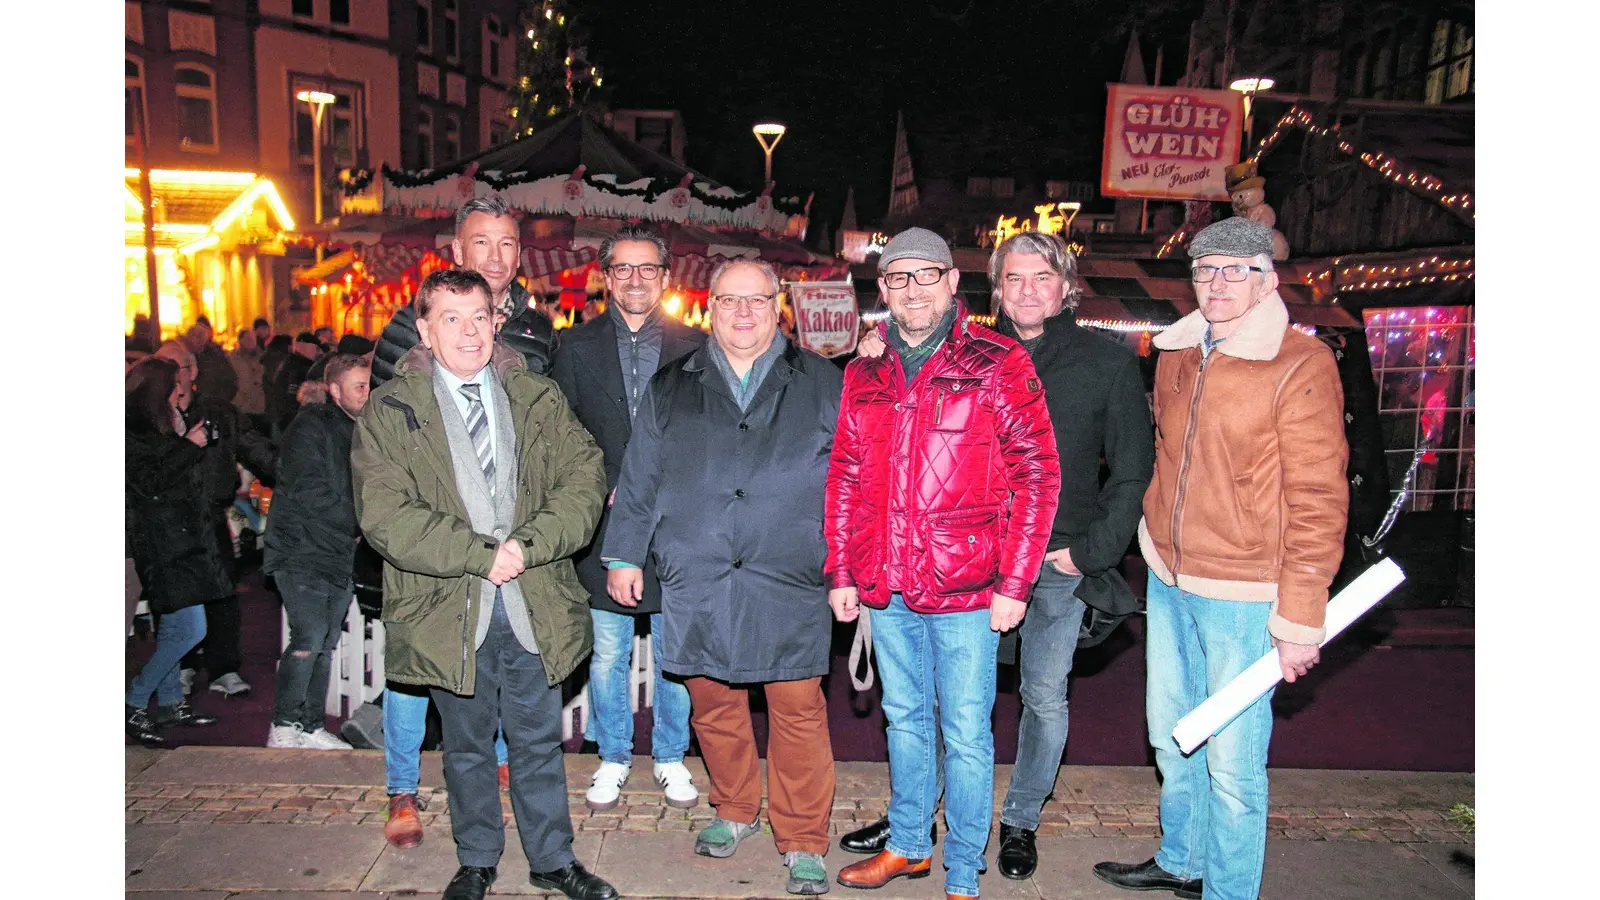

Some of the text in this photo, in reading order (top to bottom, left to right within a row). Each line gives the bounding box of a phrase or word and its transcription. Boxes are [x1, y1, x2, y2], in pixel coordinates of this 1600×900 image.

[1126, 96, 1228, 130] GLÜH-
[1125, 131, 1221, 158] WEIN
[1120, 162, 1150, 181] NEU
[1168, 166, 1211, 188] Punsch
[806, 291, 848, 300] Hier
[800, 307, 854, 333] Kakao
